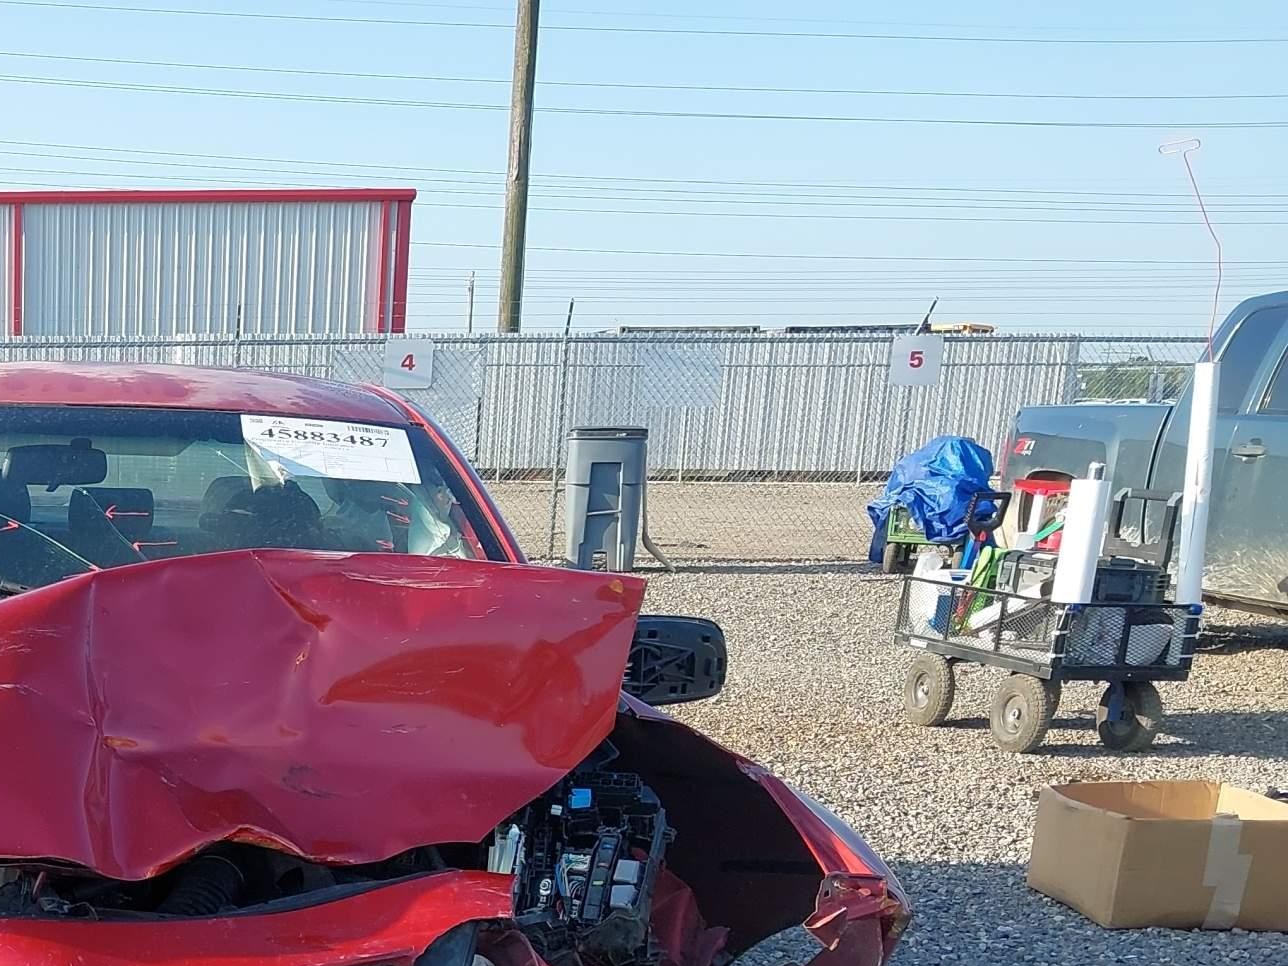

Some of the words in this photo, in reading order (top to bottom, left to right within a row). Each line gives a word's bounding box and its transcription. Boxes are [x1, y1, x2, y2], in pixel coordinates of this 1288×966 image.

[400, 354, 416, 371] 4
[909, 350, 924, 368] 5
[260, 427, 390, 449] 45883487
